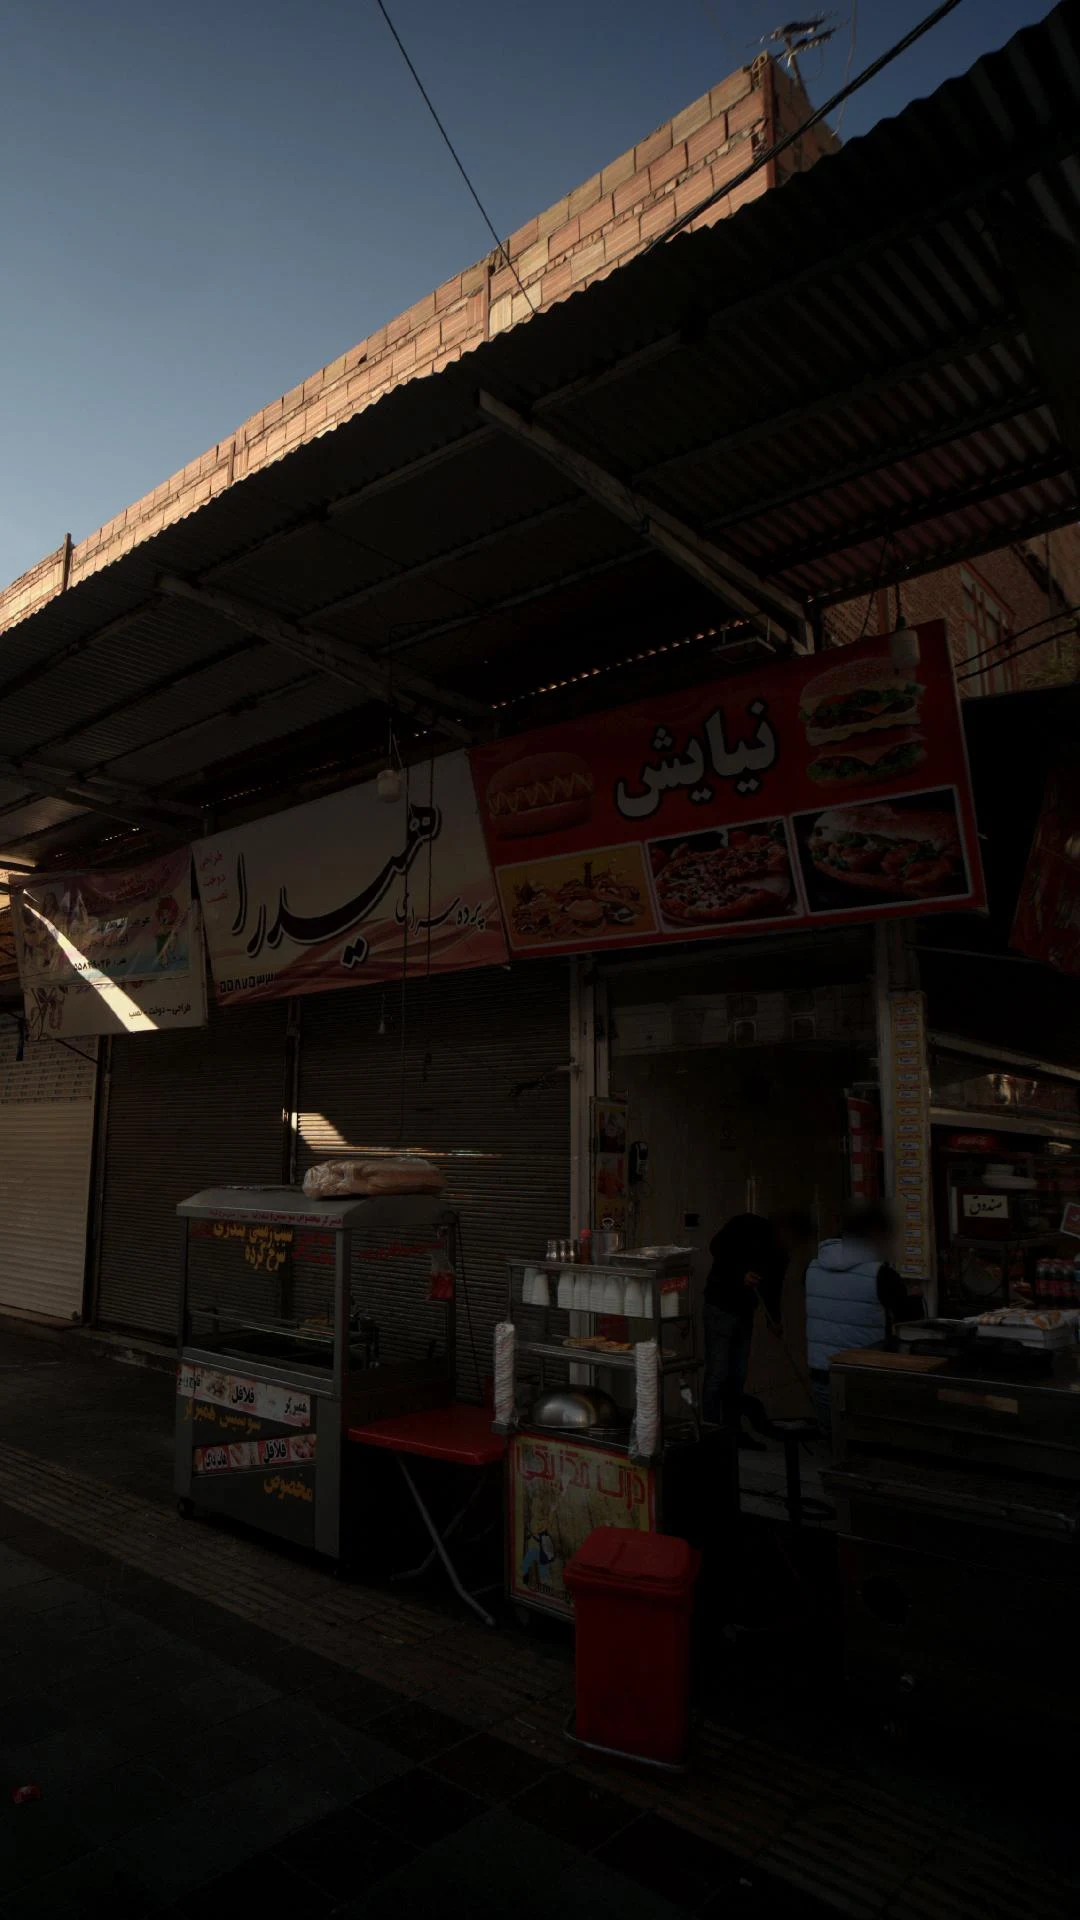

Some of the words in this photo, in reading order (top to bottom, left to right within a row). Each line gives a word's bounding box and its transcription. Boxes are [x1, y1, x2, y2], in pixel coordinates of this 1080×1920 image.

[615, 699, 778, 819] نیایش
[968, 1195, 1003, 1216] صندوق
[231, 1384, 256, 1404] فلافل
[264, 1439, 287, 1464] فلافل
